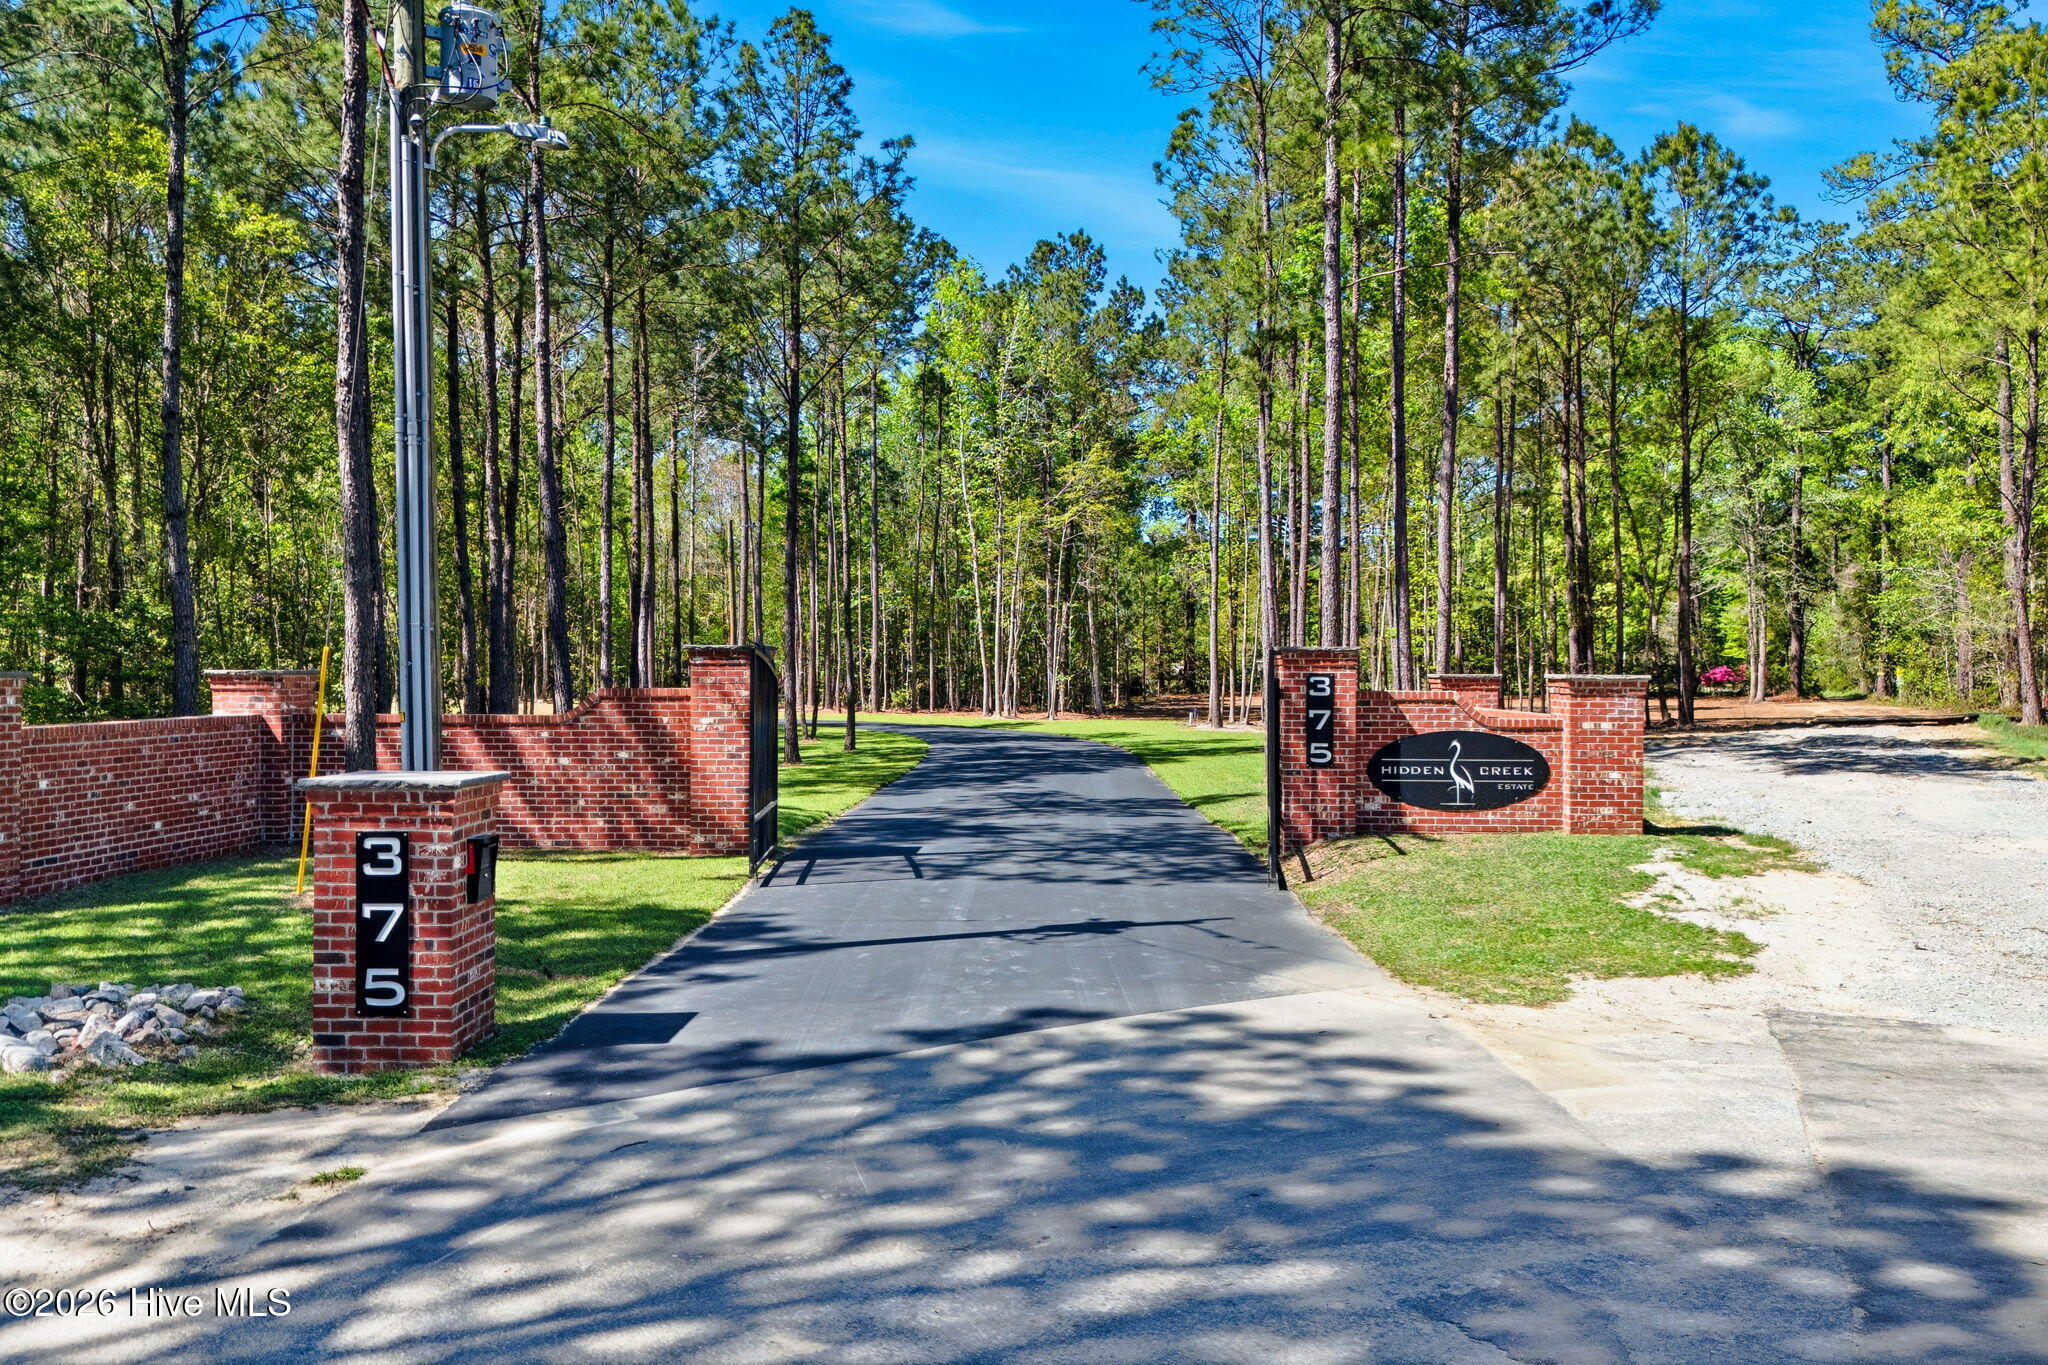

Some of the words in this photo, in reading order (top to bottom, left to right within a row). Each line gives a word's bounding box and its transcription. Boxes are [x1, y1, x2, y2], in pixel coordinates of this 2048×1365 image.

[1308, 676, 1332, 763] 375
[1381, 766, 1444, 775] HIDDEN
[1480, 766, 1533, 776] CREEK
[361, 837, 406, 1007] 375
